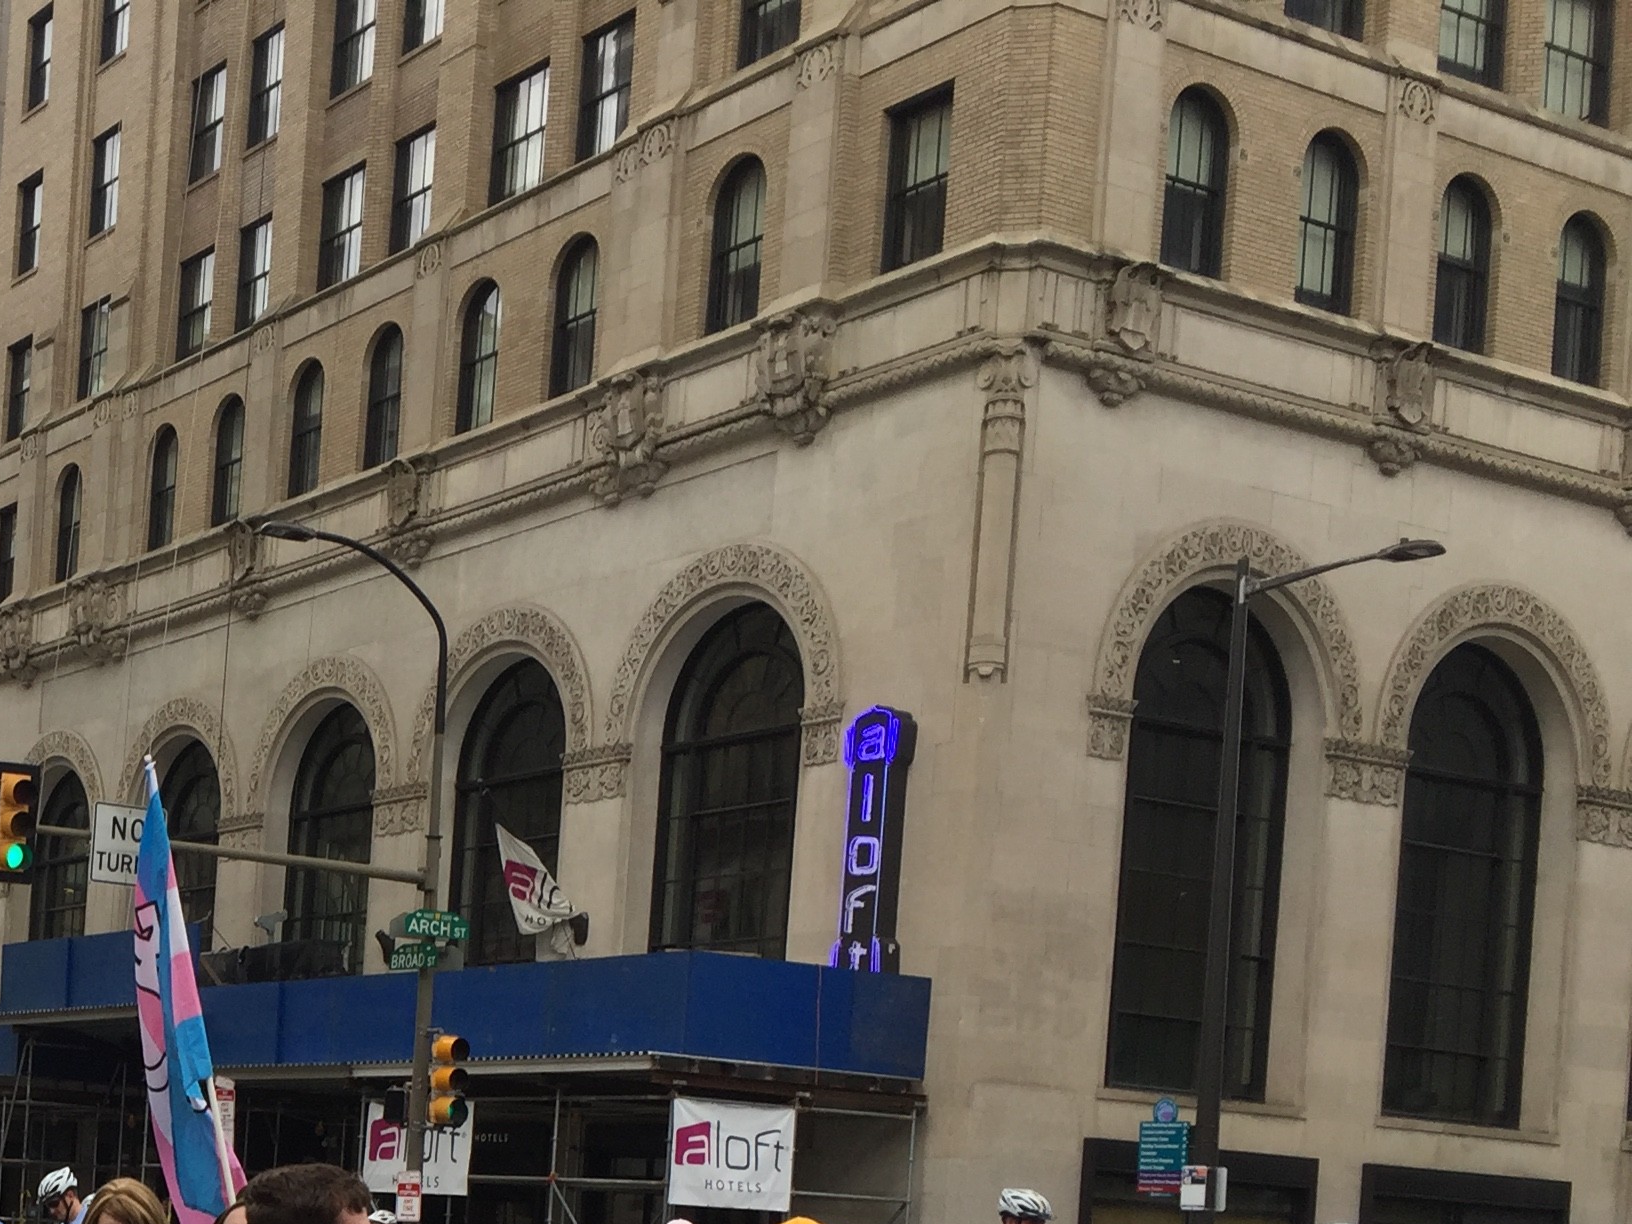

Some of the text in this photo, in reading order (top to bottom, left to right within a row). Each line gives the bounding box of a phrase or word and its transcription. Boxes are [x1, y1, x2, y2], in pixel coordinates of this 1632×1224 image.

[111, 816, 144, 842] NO
[843, 723, 886, 971] aloft
[96, 850, 138, 875] TUR
[408, 917, 466, 939] ARCH ST
[391, 953, 436, 969] BROAD ST
[474, 1132, 509, 1143] HOTELS
[675, 1120, 784, 1173] aloft
[704, 1179, 762, 1194] HOTELS
